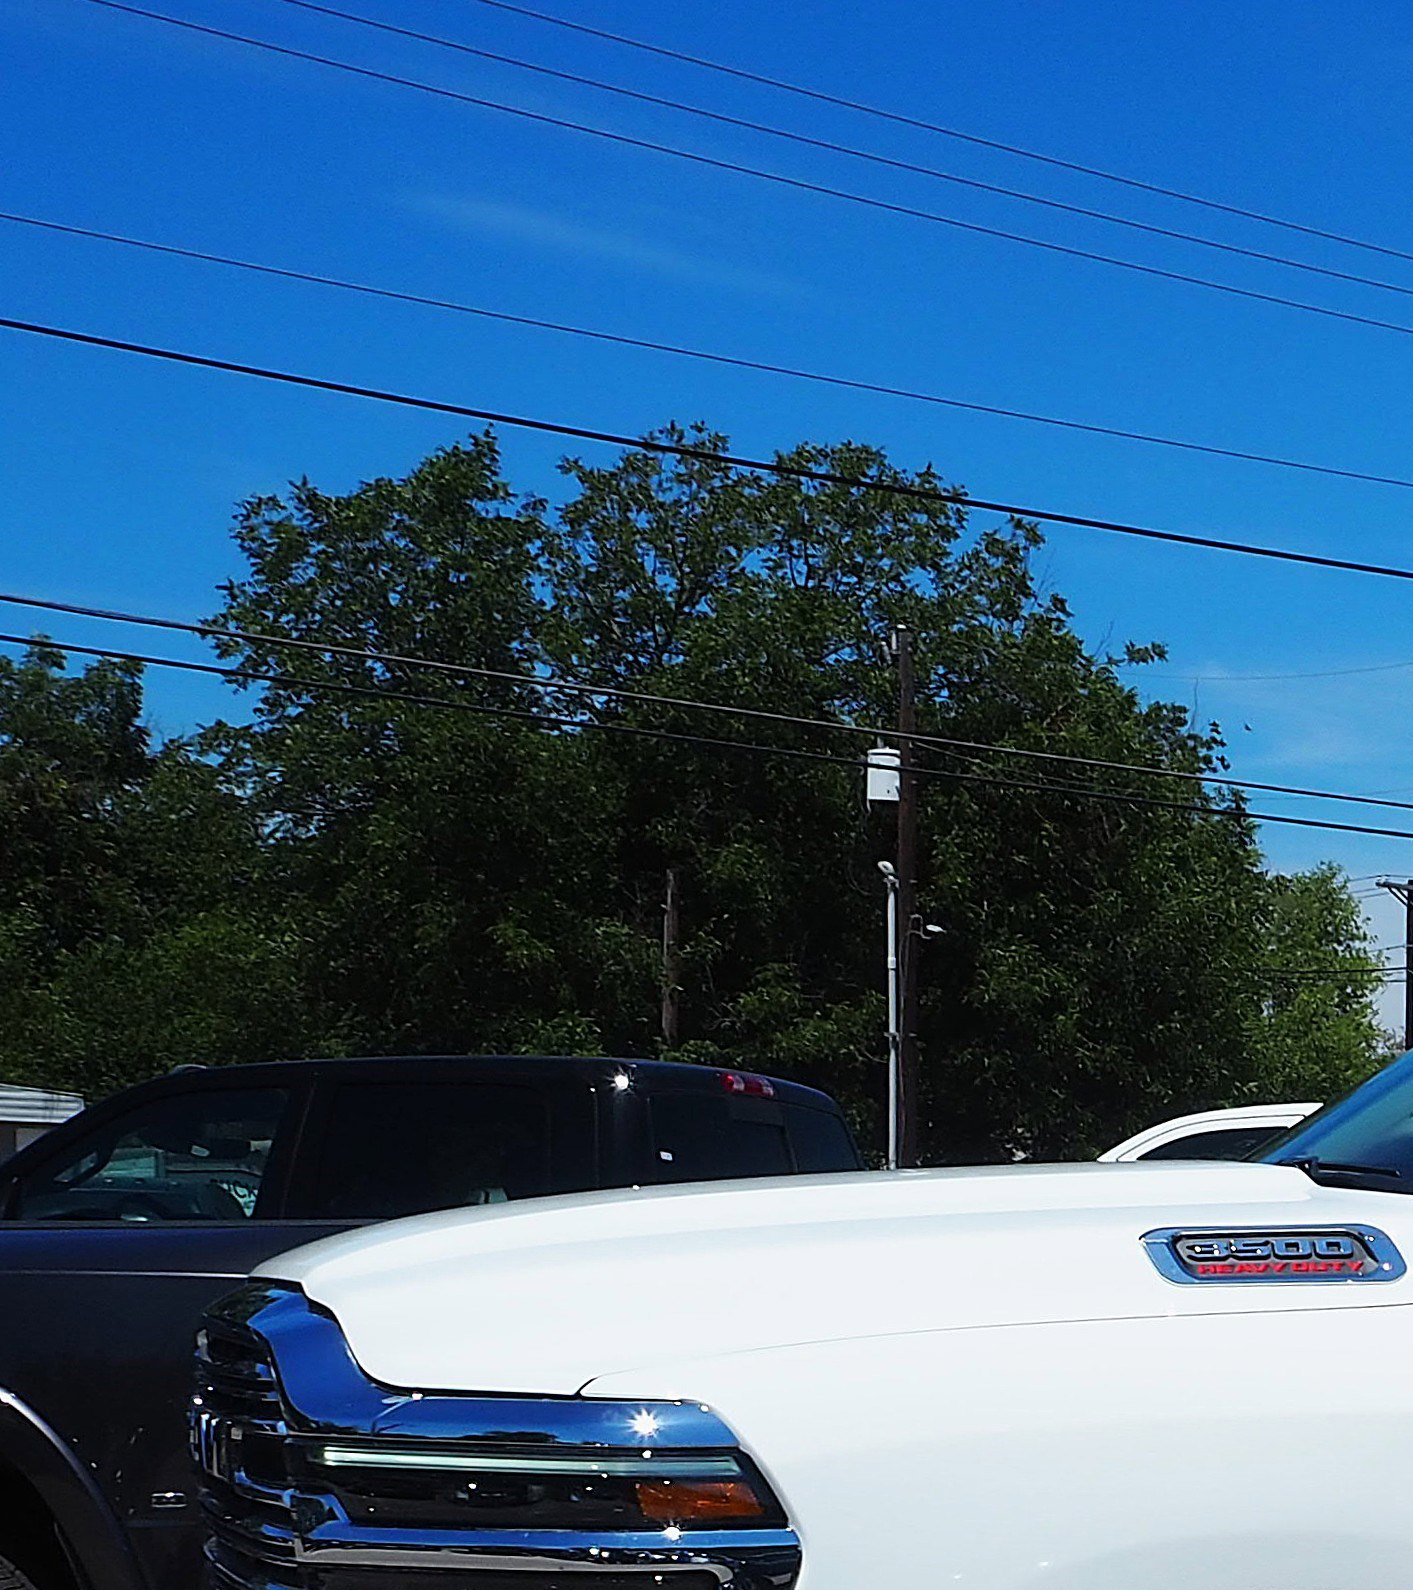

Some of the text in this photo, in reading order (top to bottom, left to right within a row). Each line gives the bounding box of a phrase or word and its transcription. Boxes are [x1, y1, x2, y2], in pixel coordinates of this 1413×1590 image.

[1185, 1239, 1355, 1261] 3500
[1197, 1261, 1364, 1275] HEAVY DUTY
